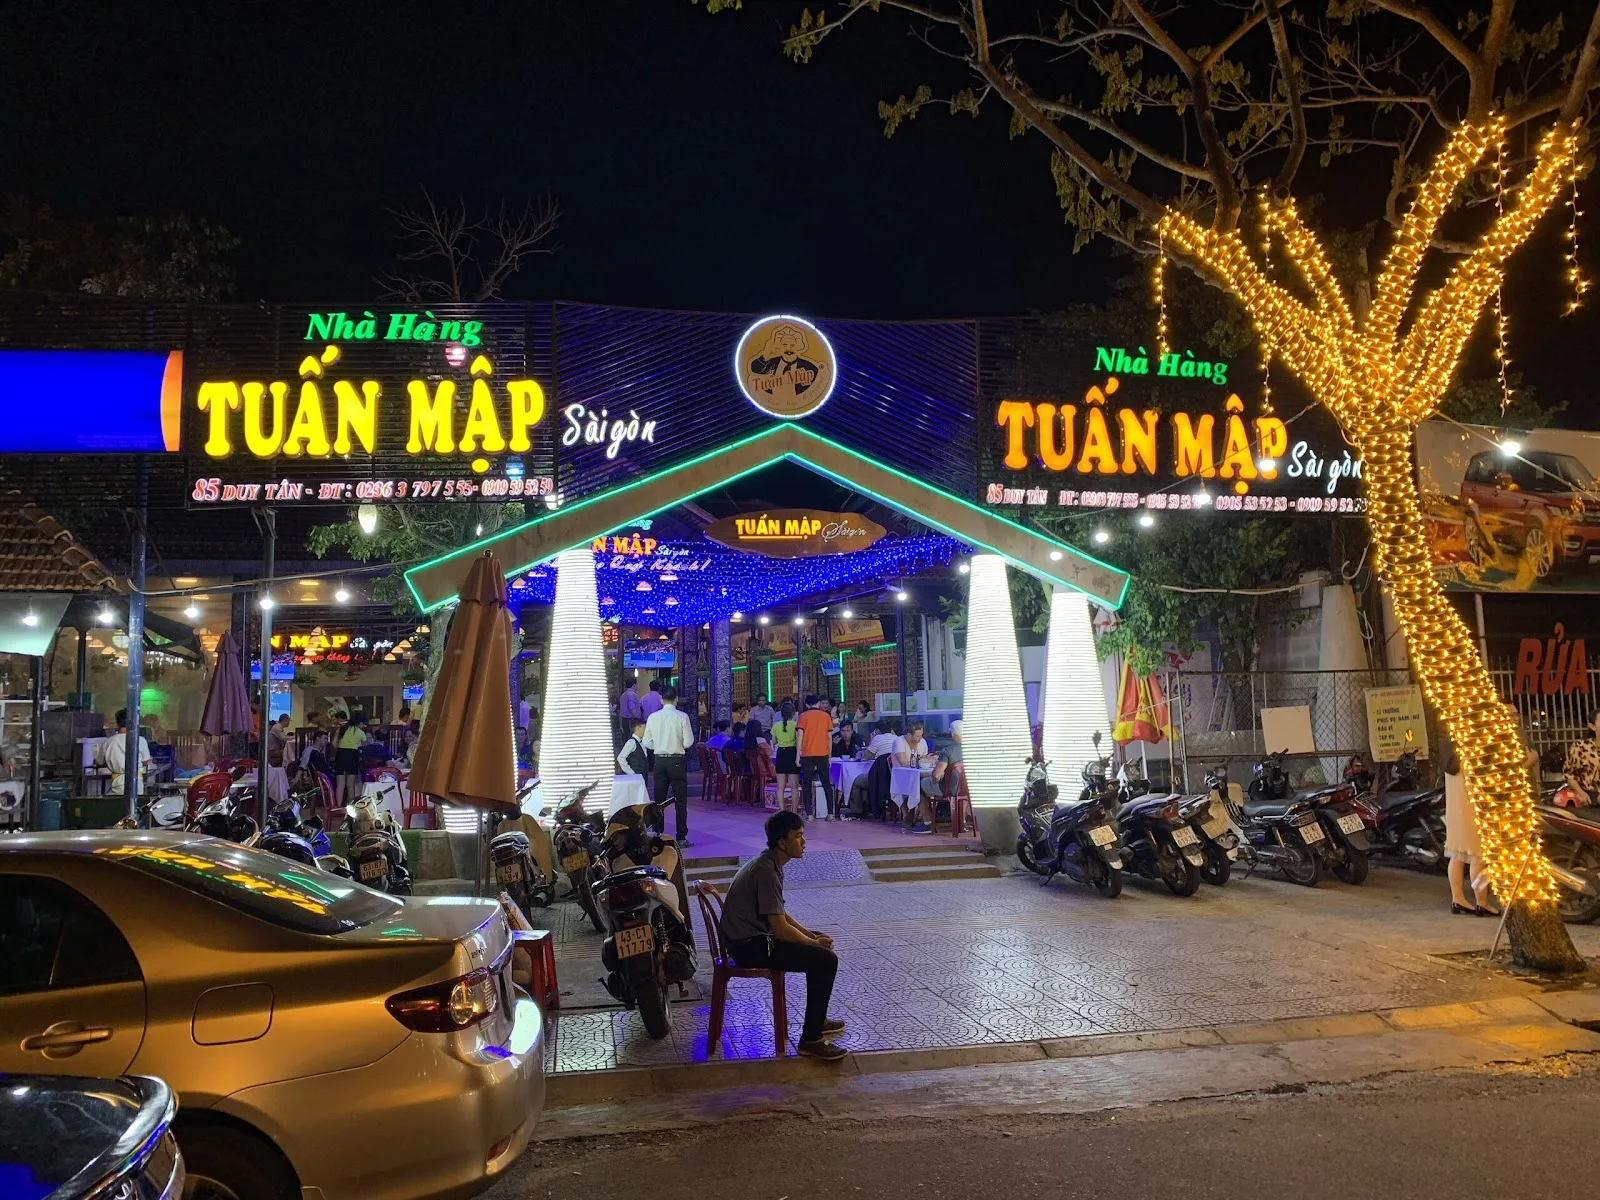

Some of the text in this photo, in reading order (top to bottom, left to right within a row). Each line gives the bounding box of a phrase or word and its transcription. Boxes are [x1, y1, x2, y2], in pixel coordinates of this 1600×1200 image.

[303, 310, 483, 347] Nhà Hàng
[1093, 346, 1229, 386] Nhà Hàng
[197, 345, 545, 473] TUẤN MẬP
[997, 376, 1288, 495] TUẤN MẬP
[192, 478, 221, 501] 85
[221, 484, 261, 501] DUY
[264, 478, 303, 500] TÂN
[355, 480, 393, 498] 0236
[987, 482, 1004, 505] 85
[1003, 488, 1026, 505] DUY
[1026, 485, 1049, 506] TÂN
[1216, 495, 1243, 511] 0905
[1244, 496, 1259, 511] 53
[1259, 496, 1274, 511] 52
[1274, 496, 1288, 511] 53
[1297, 497, 1323, 512] 0909
[735, 513, 780, 536] TUẤN
[784, 516, 822, 540] MẬP
[613, 532, 657, 559] MẬP
[1513, 621, 1590, 695] RỬA
